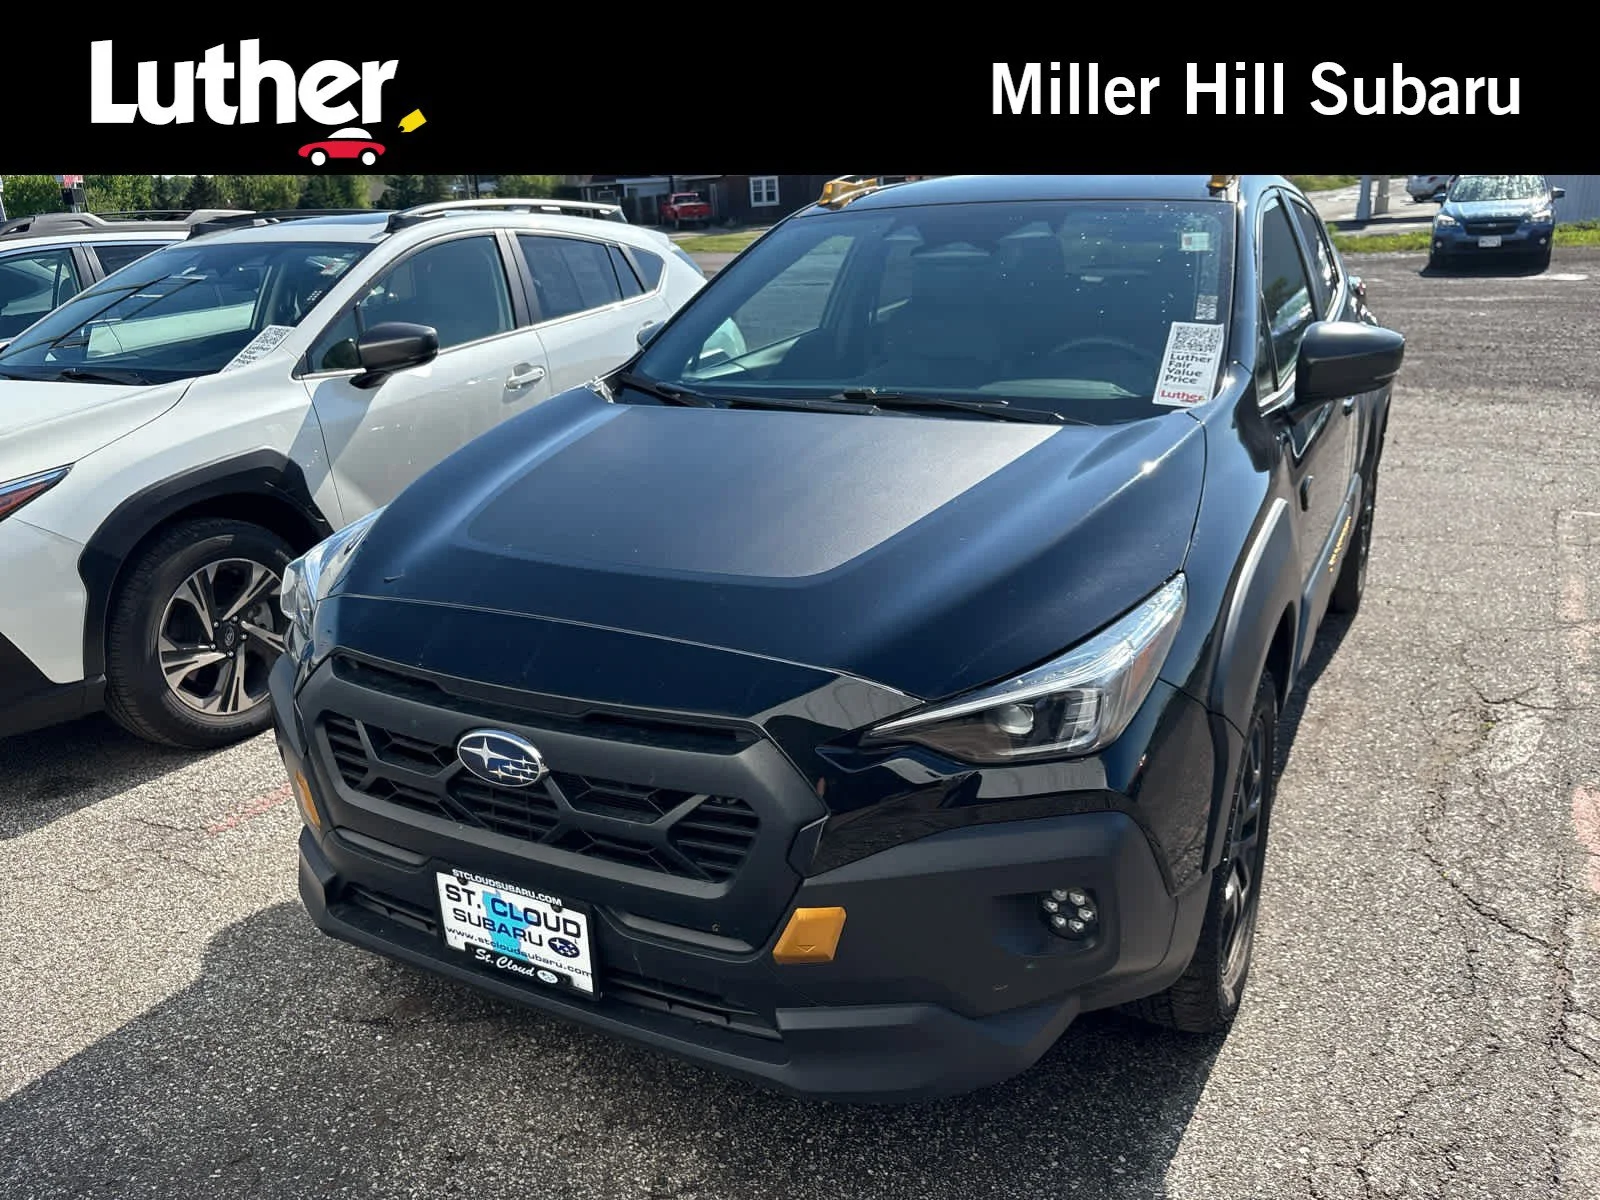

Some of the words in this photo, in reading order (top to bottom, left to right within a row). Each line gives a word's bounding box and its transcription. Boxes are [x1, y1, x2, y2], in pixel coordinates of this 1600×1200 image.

[1167, 367, 1203, 377] Value
[1168, 360, 1192, 368] Fair
[1170, 353, 1212, 363] Luther
[1165, 374, 1198, 384] Price
[452, 868, 563, 907] STCLOUDSUBARU.COM
[445, 883, 482, 909] ST.
[490, 897, 581, 939] CLOUD
[453, 908, 543, 947] SUBARU
[446, 926, 592, 978] www.stcloudsubaru.com
[475, 948, 495, 965] St.
[496, 955, 535, 977] Cloud
